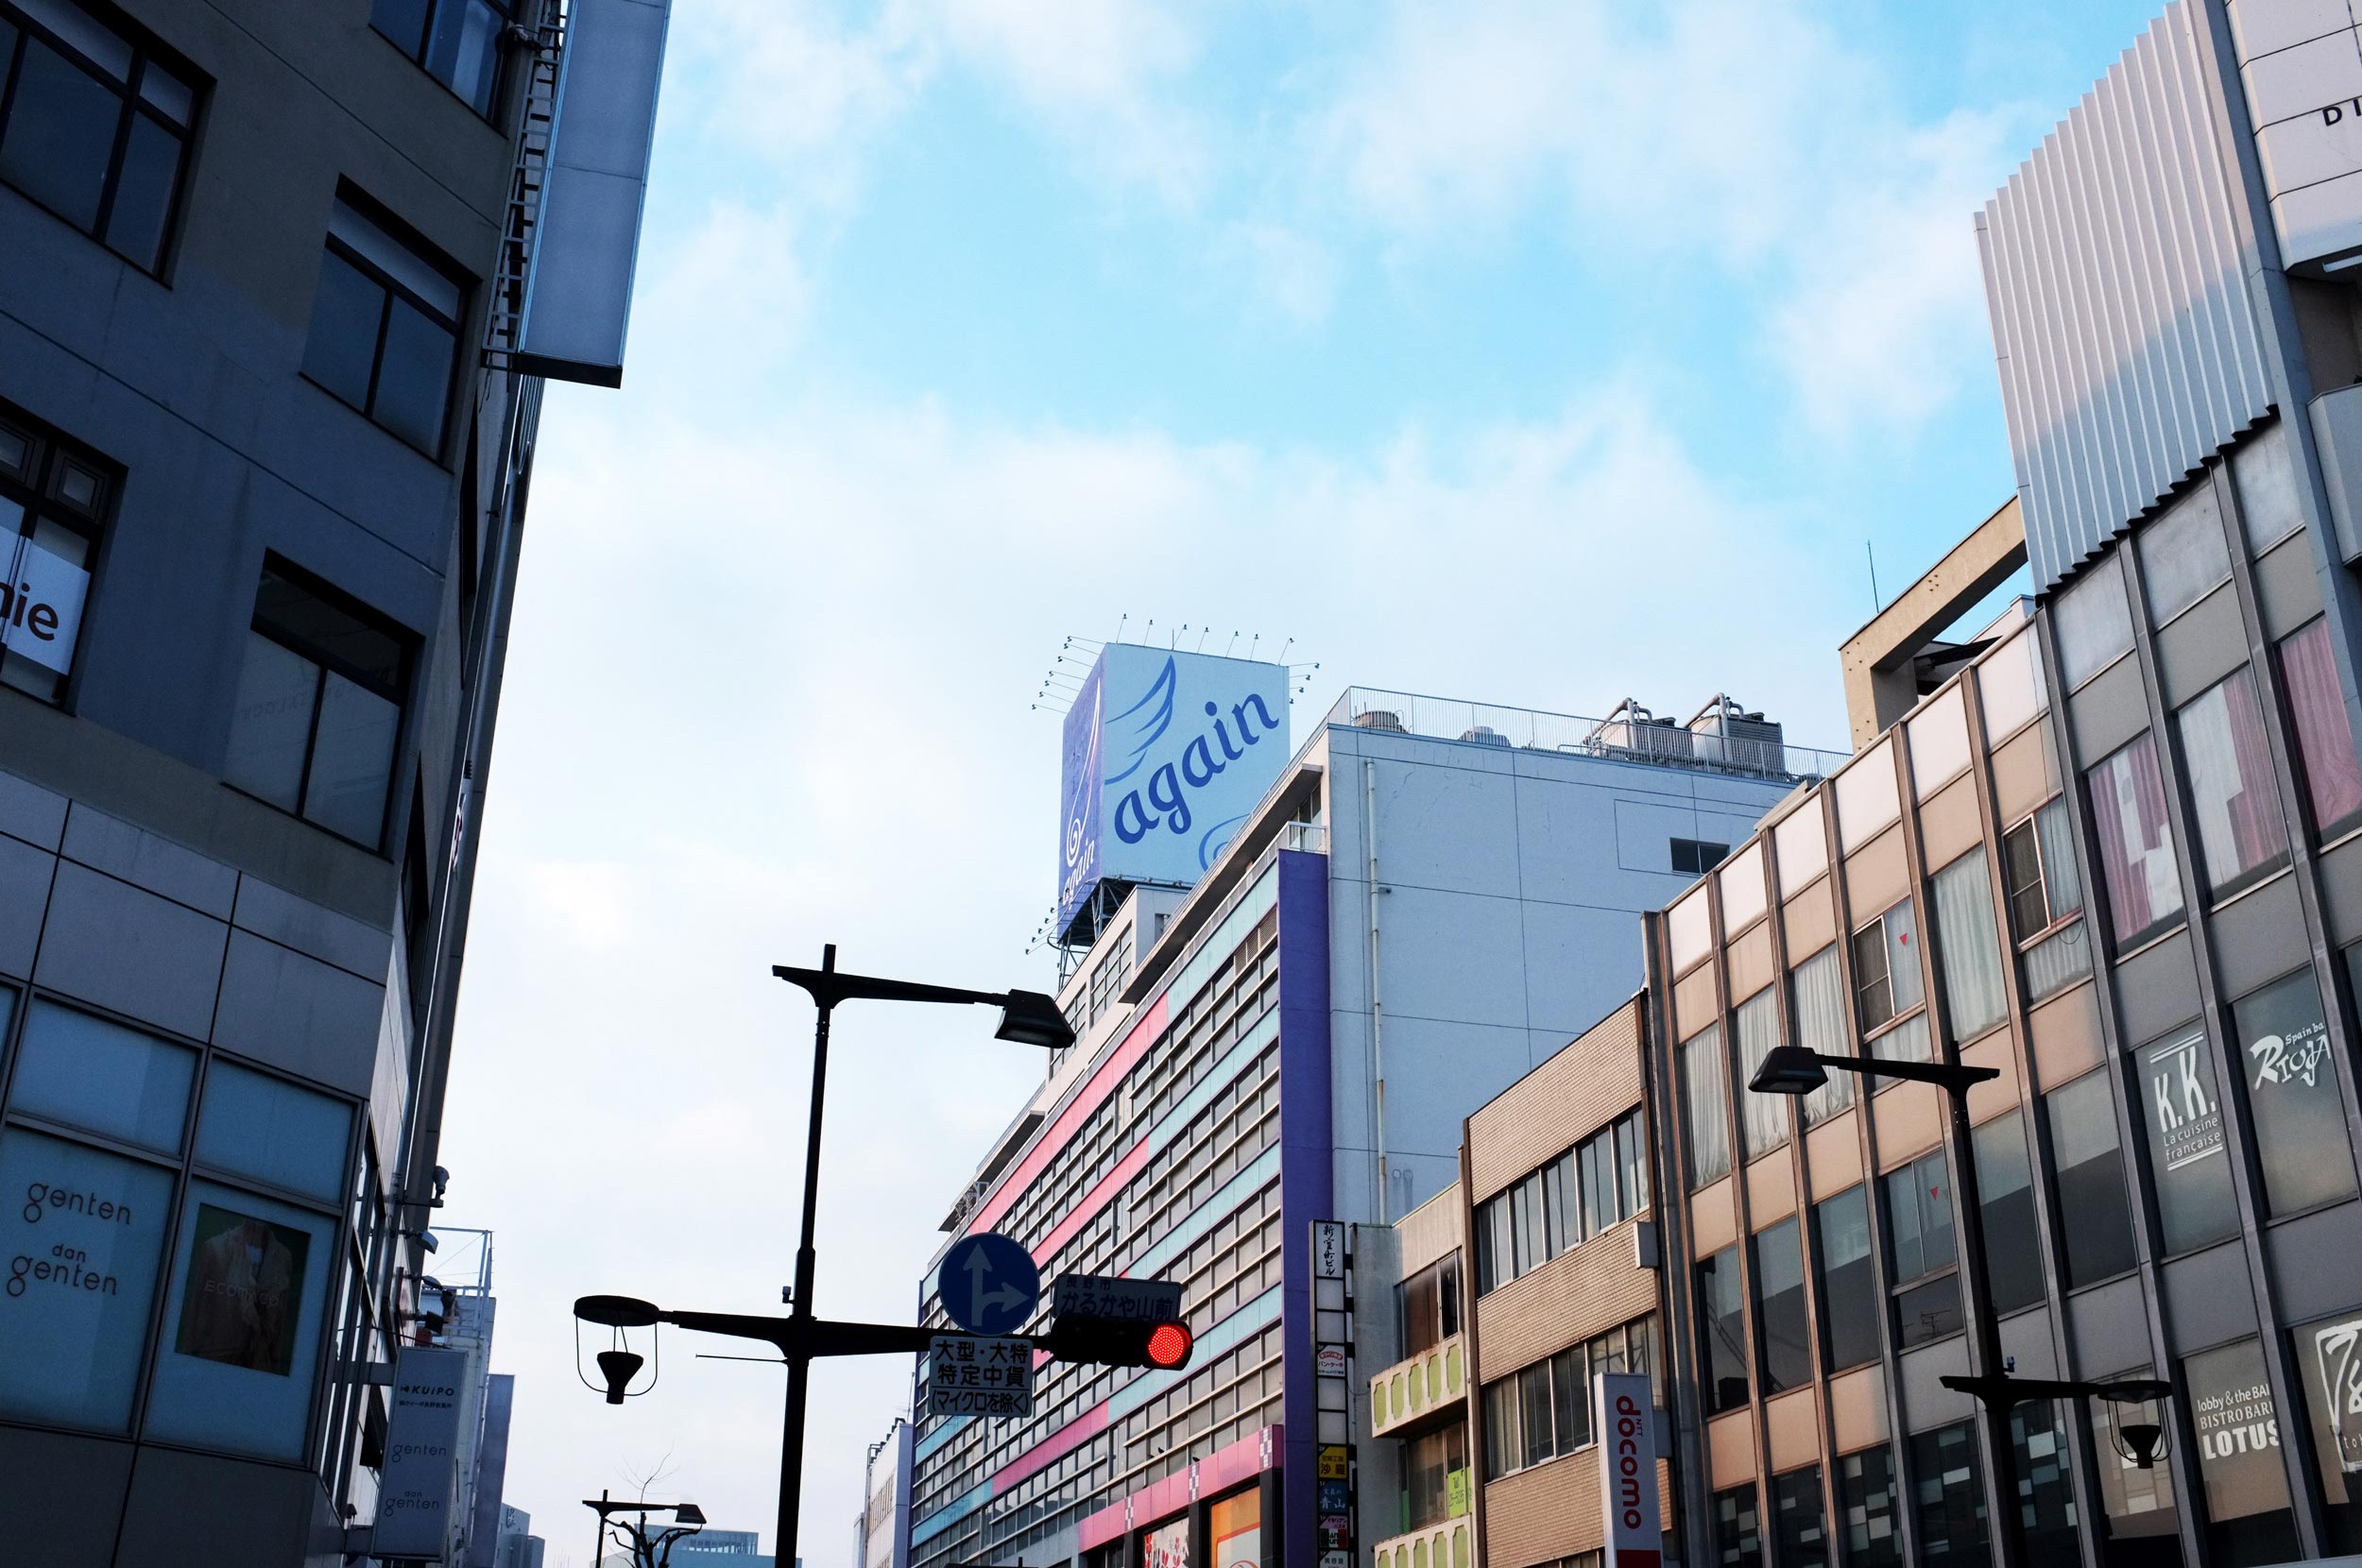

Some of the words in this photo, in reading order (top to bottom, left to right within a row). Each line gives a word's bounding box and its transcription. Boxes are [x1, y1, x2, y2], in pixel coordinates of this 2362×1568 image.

[1114, 693, 1279, 844] again
[1063, 838, 1095, 911] again
[2285, 1028, 2313, 1046] Spain
[2153, 1046, 2217, 1133] K.K.
[2165, 1132, 2221, 1162] française
[24, 1183, 131, 1225] genten
[52, 1244, 87, 1263] dan
[7, 1255, 117, 1297] genten
[1066, 1277, 1112, 1291] 長野市
[1060, 1291, 1173, 1321] かるかや山前
[934, 1339, 1029, 1365] 大型・大特
[937, 1364, 1025, 1389] 特定中貨
[931, 1389, 1029, 1416] (マイクロを除く)
[2197, 1394, 2224, 1413] lobby
[2225, 1390, 2234, 1406] &
[2234, 1389, 2252, 1404] the
[2199, 1408, 2243, 1430] BISTRO
[2202, 1419, 2280, 1460] LOTUS
[392, 1444, 447, 1463] genten
[1616, 1395, 1642, 1530] docomo
[385, 1497, 440, 1517] genten
[404, 1490, 422, 1498] dan
